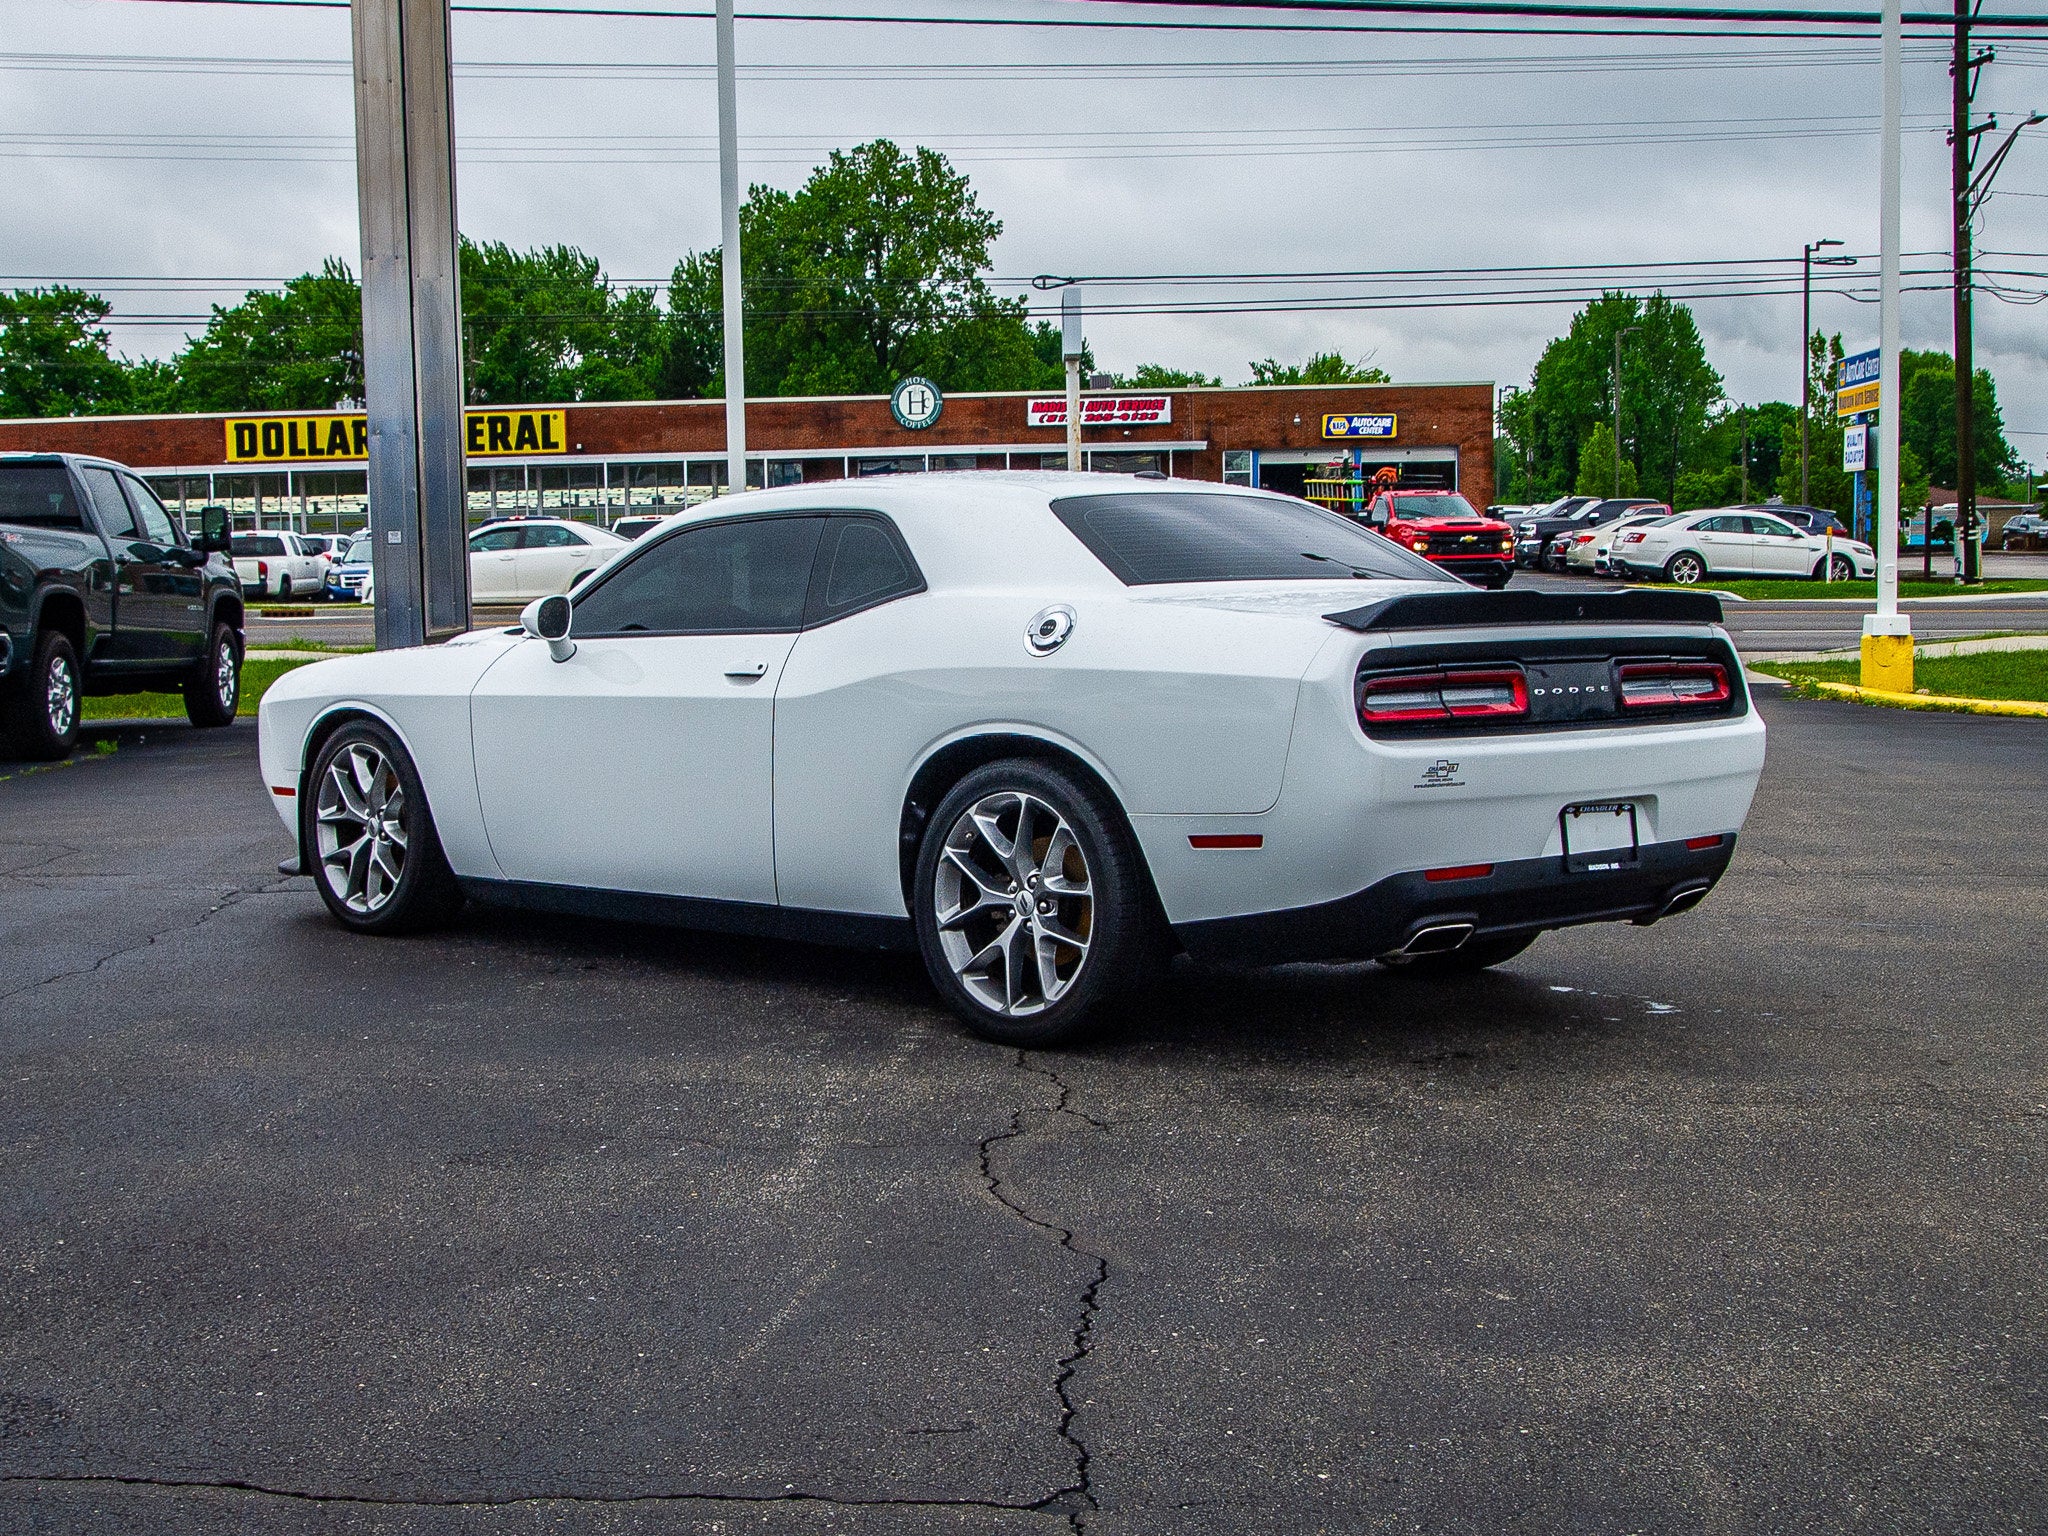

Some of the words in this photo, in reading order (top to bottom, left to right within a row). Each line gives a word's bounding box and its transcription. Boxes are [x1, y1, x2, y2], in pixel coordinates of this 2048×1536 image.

[906, 377, 926, 385] HOS
[1085, 400, 1116, 412] AUTO
[1117, 399, 1166, 411] SERVICE
[900, 417, 932, 429] COFFEE
[234, 420, 368, 458] DOLLAR
[467, 414, 559, 451] ERAL
[1358, 426, 1384, 435] CENTER
[1534, 685, 1609, 696] DODGE
